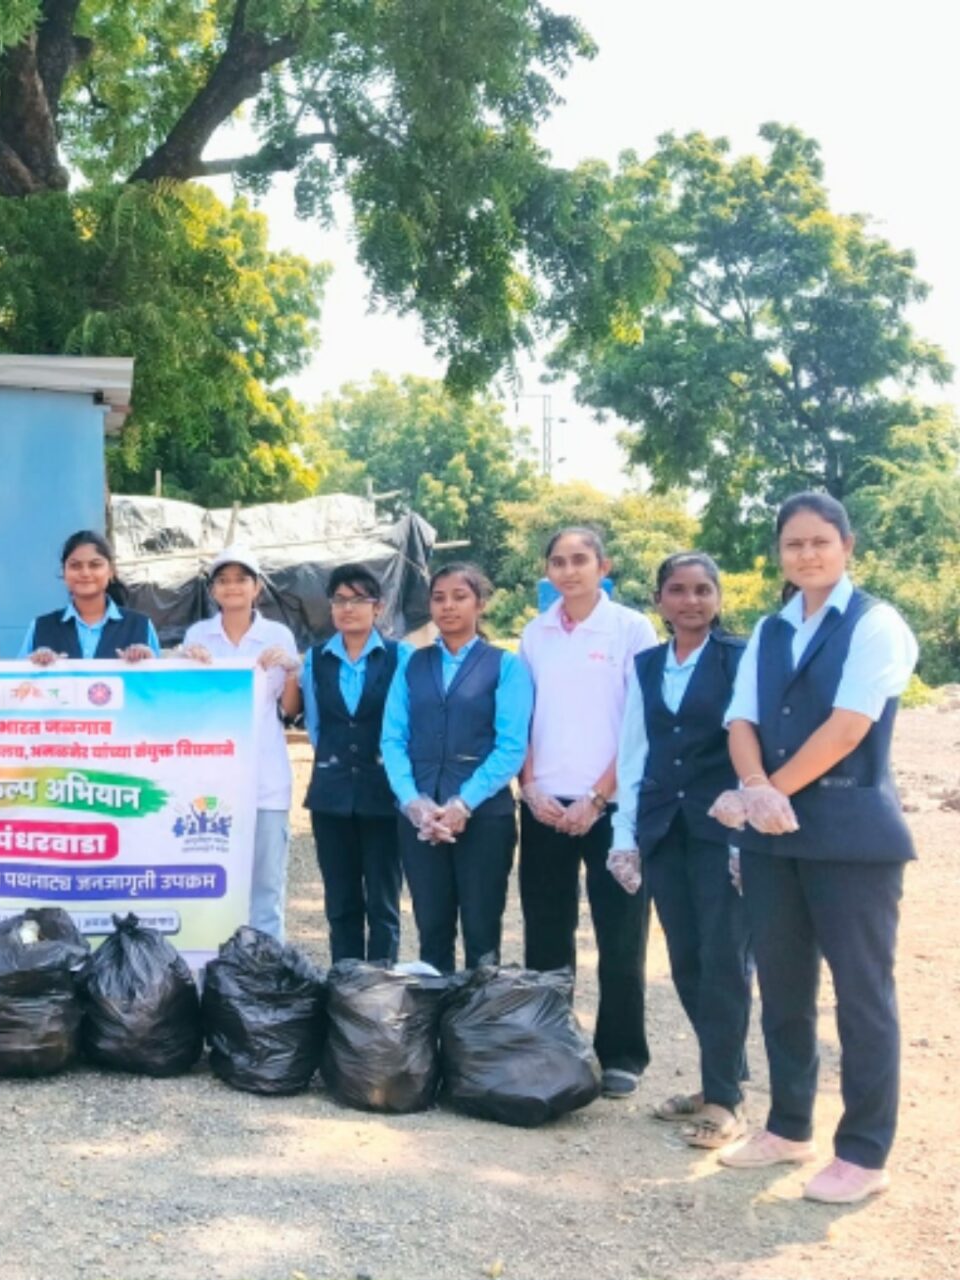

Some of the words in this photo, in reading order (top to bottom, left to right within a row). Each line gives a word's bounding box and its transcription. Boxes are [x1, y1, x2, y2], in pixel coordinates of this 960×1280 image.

[45, 719, 112, 736] जळगाव
[45, 771, 142, 810] अभियान
[4, 871, 71, 892] पथनाट्य
[75, 869, 157, 896] जनजागृती
[160, 872, 216, 889] उपक्रम
